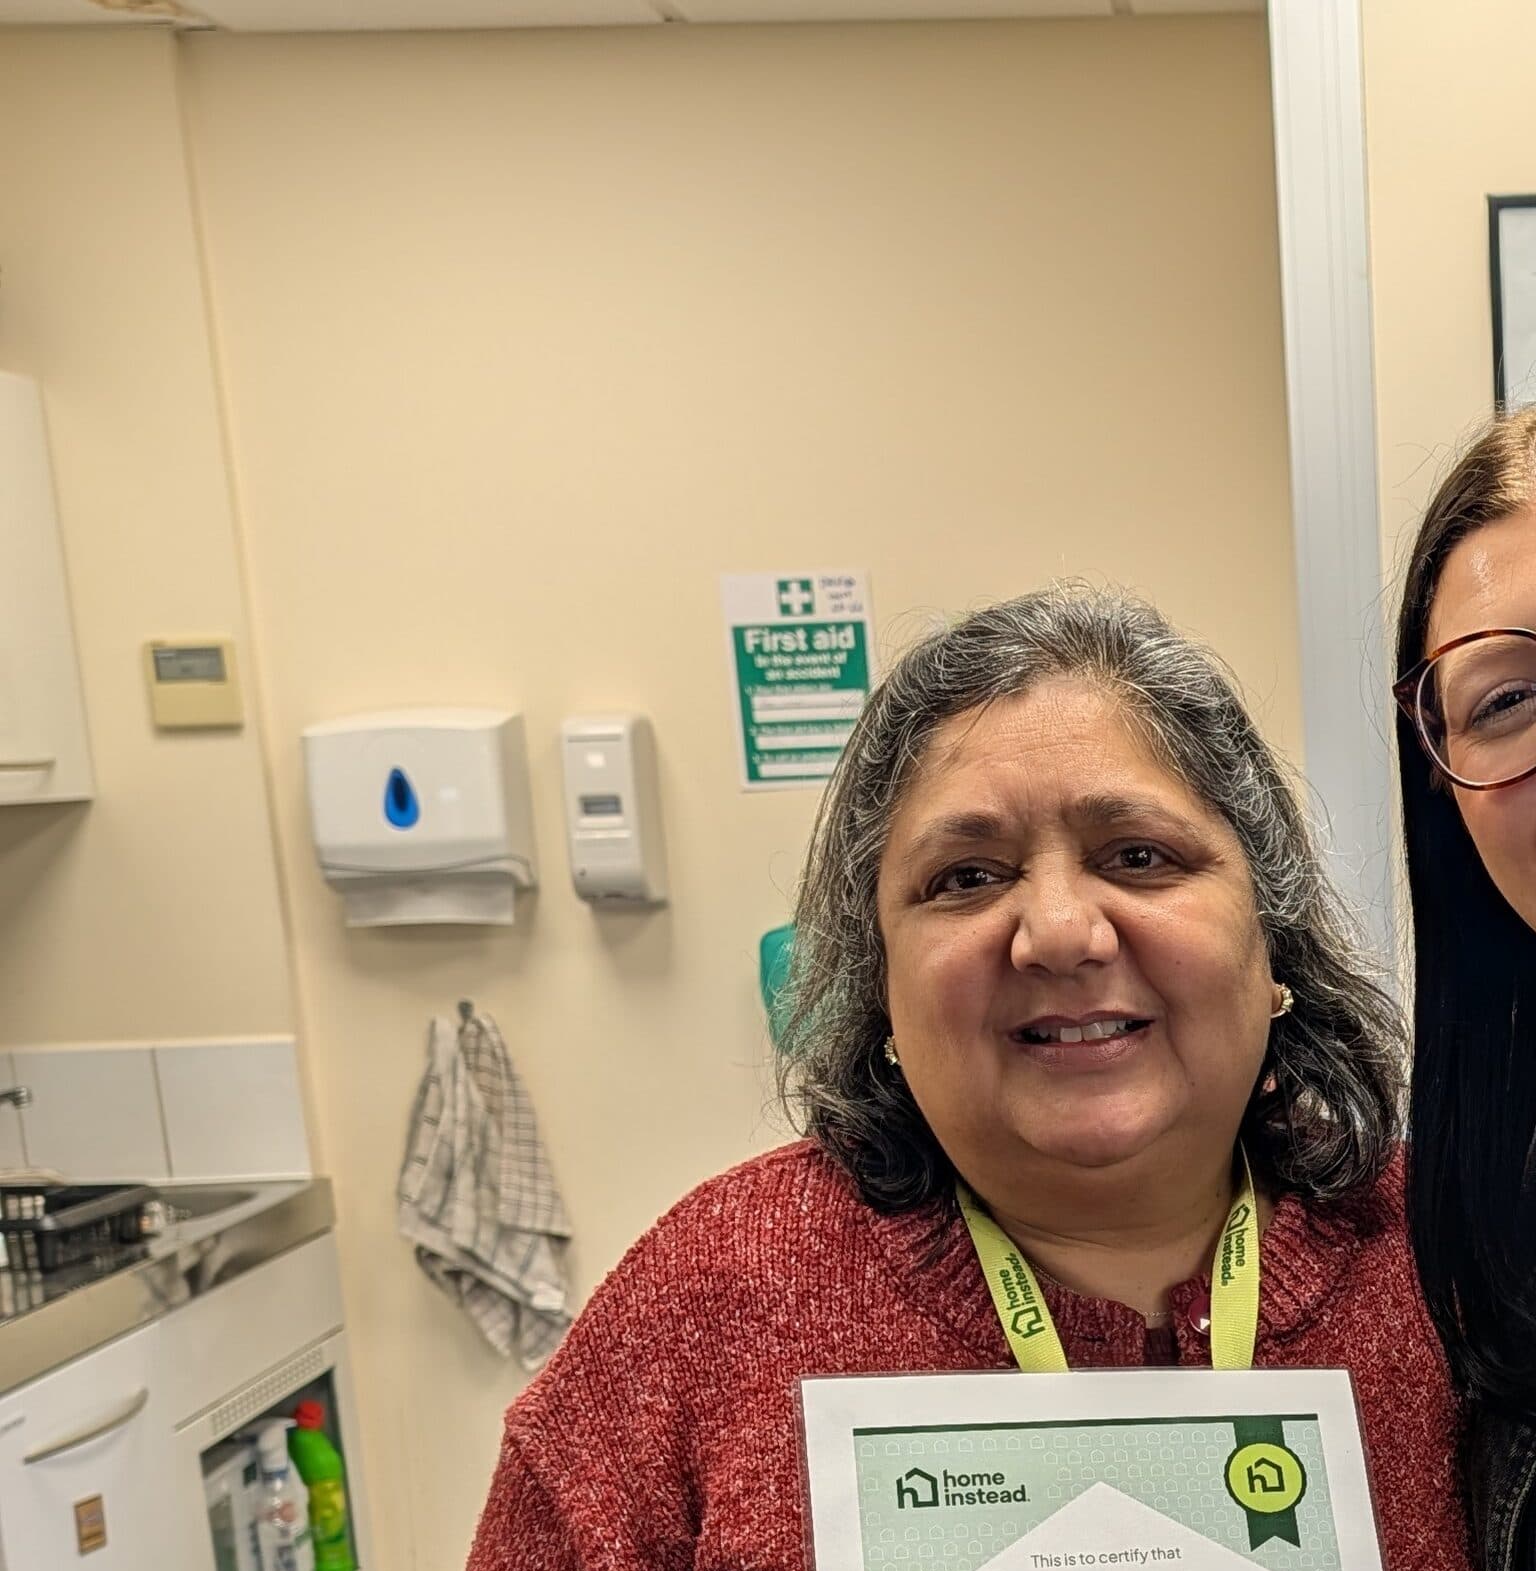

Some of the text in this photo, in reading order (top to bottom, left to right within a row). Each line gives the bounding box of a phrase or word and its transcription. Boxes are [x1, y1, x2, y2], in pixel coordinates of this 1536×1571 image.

[743, 623, 856, 654] First aid
[771, 653, 793, 667] the
[795, 652, 831, 666] event
[831, 650, 848, 664] of
[765, 664, 841, 681] an accident
[1235, 1227, 1250, 1267] home
[999, 1269, 1020, 1310] home
[943, 1469, 1005, 1488] home
[1031, 1547, 1182, 1568] This is to certify that
